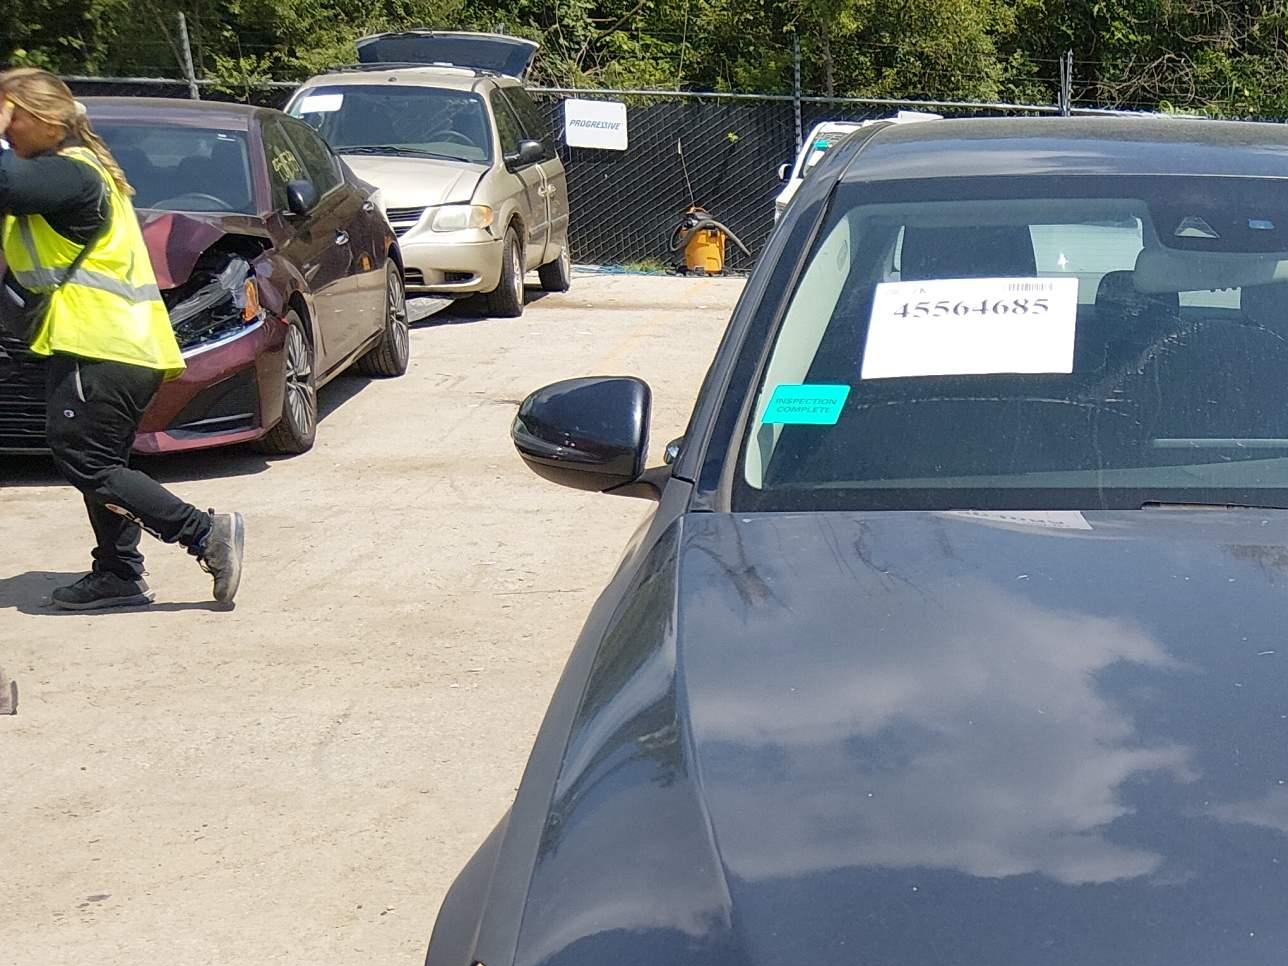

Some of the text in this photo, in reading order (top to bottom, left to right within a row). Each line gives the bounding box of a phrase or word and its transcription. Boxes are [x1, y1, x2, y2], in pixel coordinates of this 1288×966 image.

[569, 119, 621, 130] PROGRESSIVE
[893, 298, 1049, 318] 45564685
[775, 397, 838, 405] INSPECTION
[776, 406, 831, 414] COMPLETE
